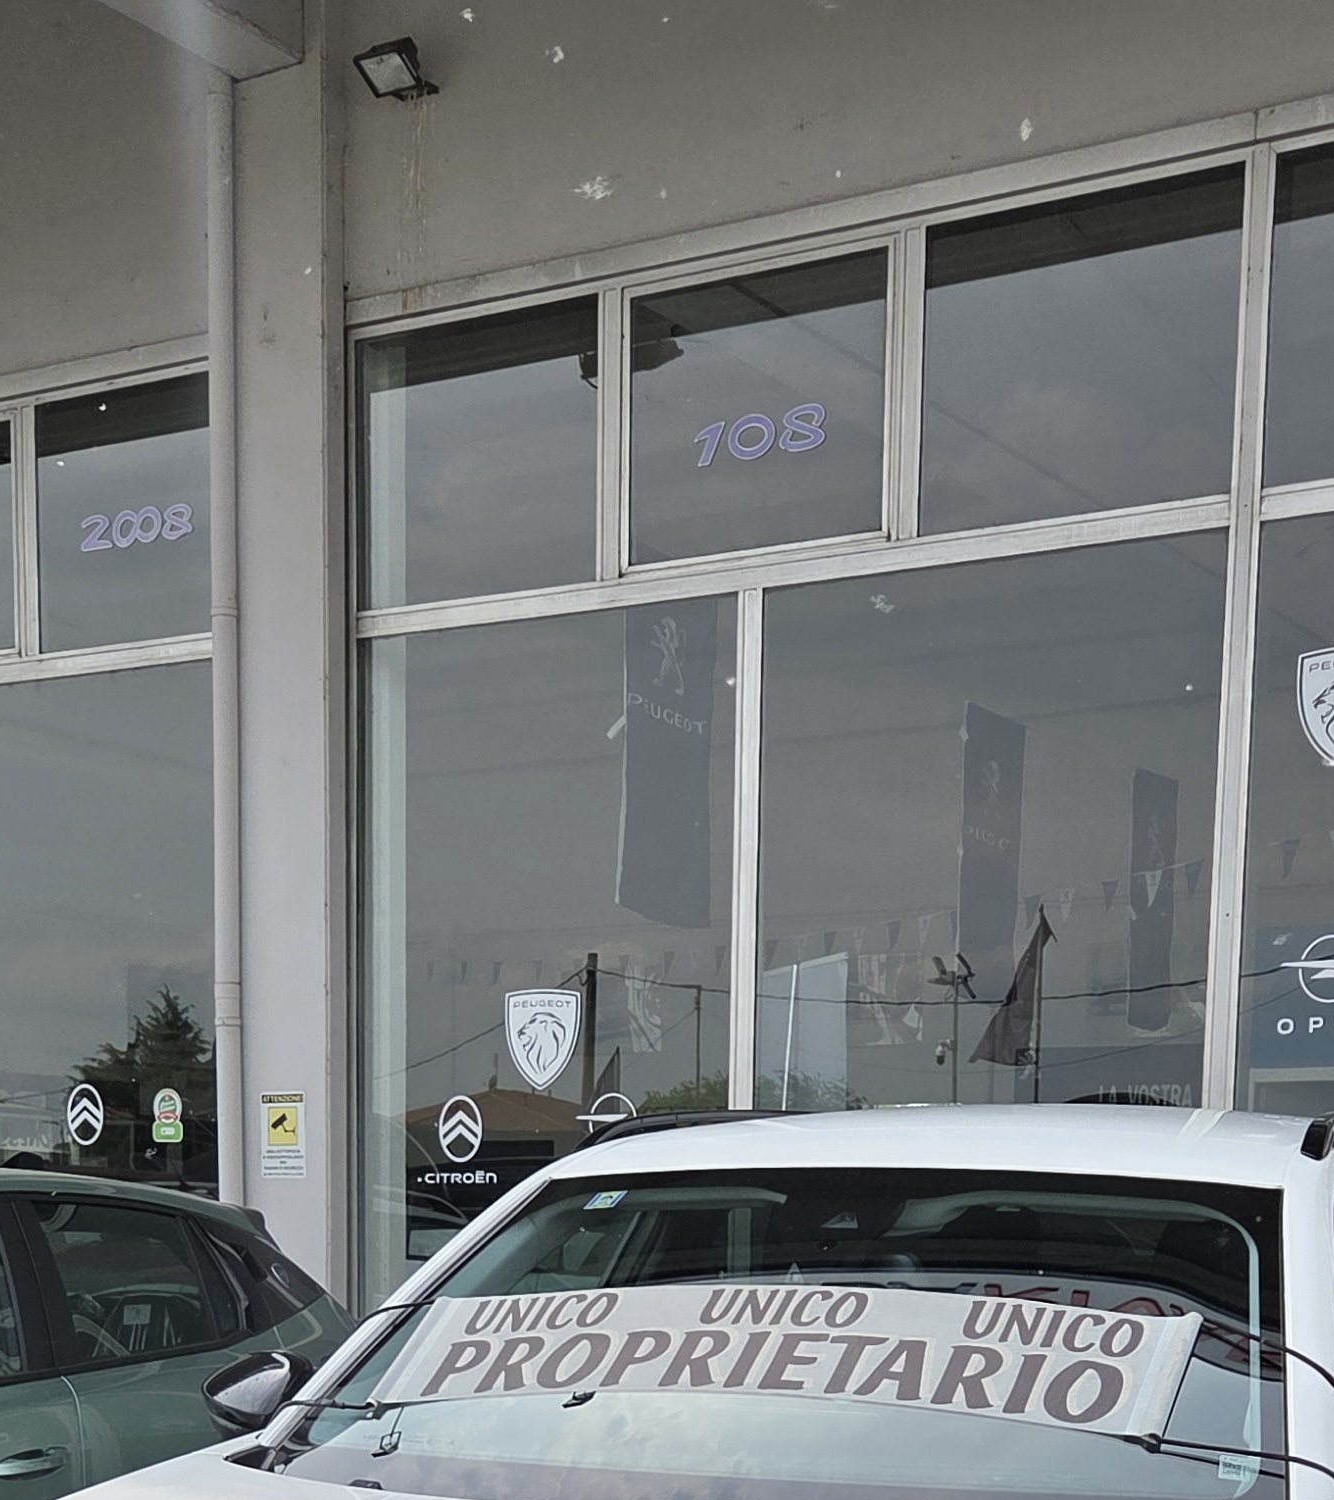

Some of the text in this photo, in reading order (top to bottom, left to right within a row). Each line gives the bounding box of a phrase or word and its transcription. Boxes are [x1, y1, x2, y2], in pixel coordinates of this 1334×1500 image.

[693, 403, 827, 468] 108
[80, 503, 193, 552] 2008
[513, 999, 572, 1009] PEUGEOT
[464, 1292, 620, 1336] UNICO
[699, 1288, 870, 1328] UNICO
[964, 1301, 1146, 1358] UNICO
[422, 1328, 1126, 1425] PROPRIETARIO
